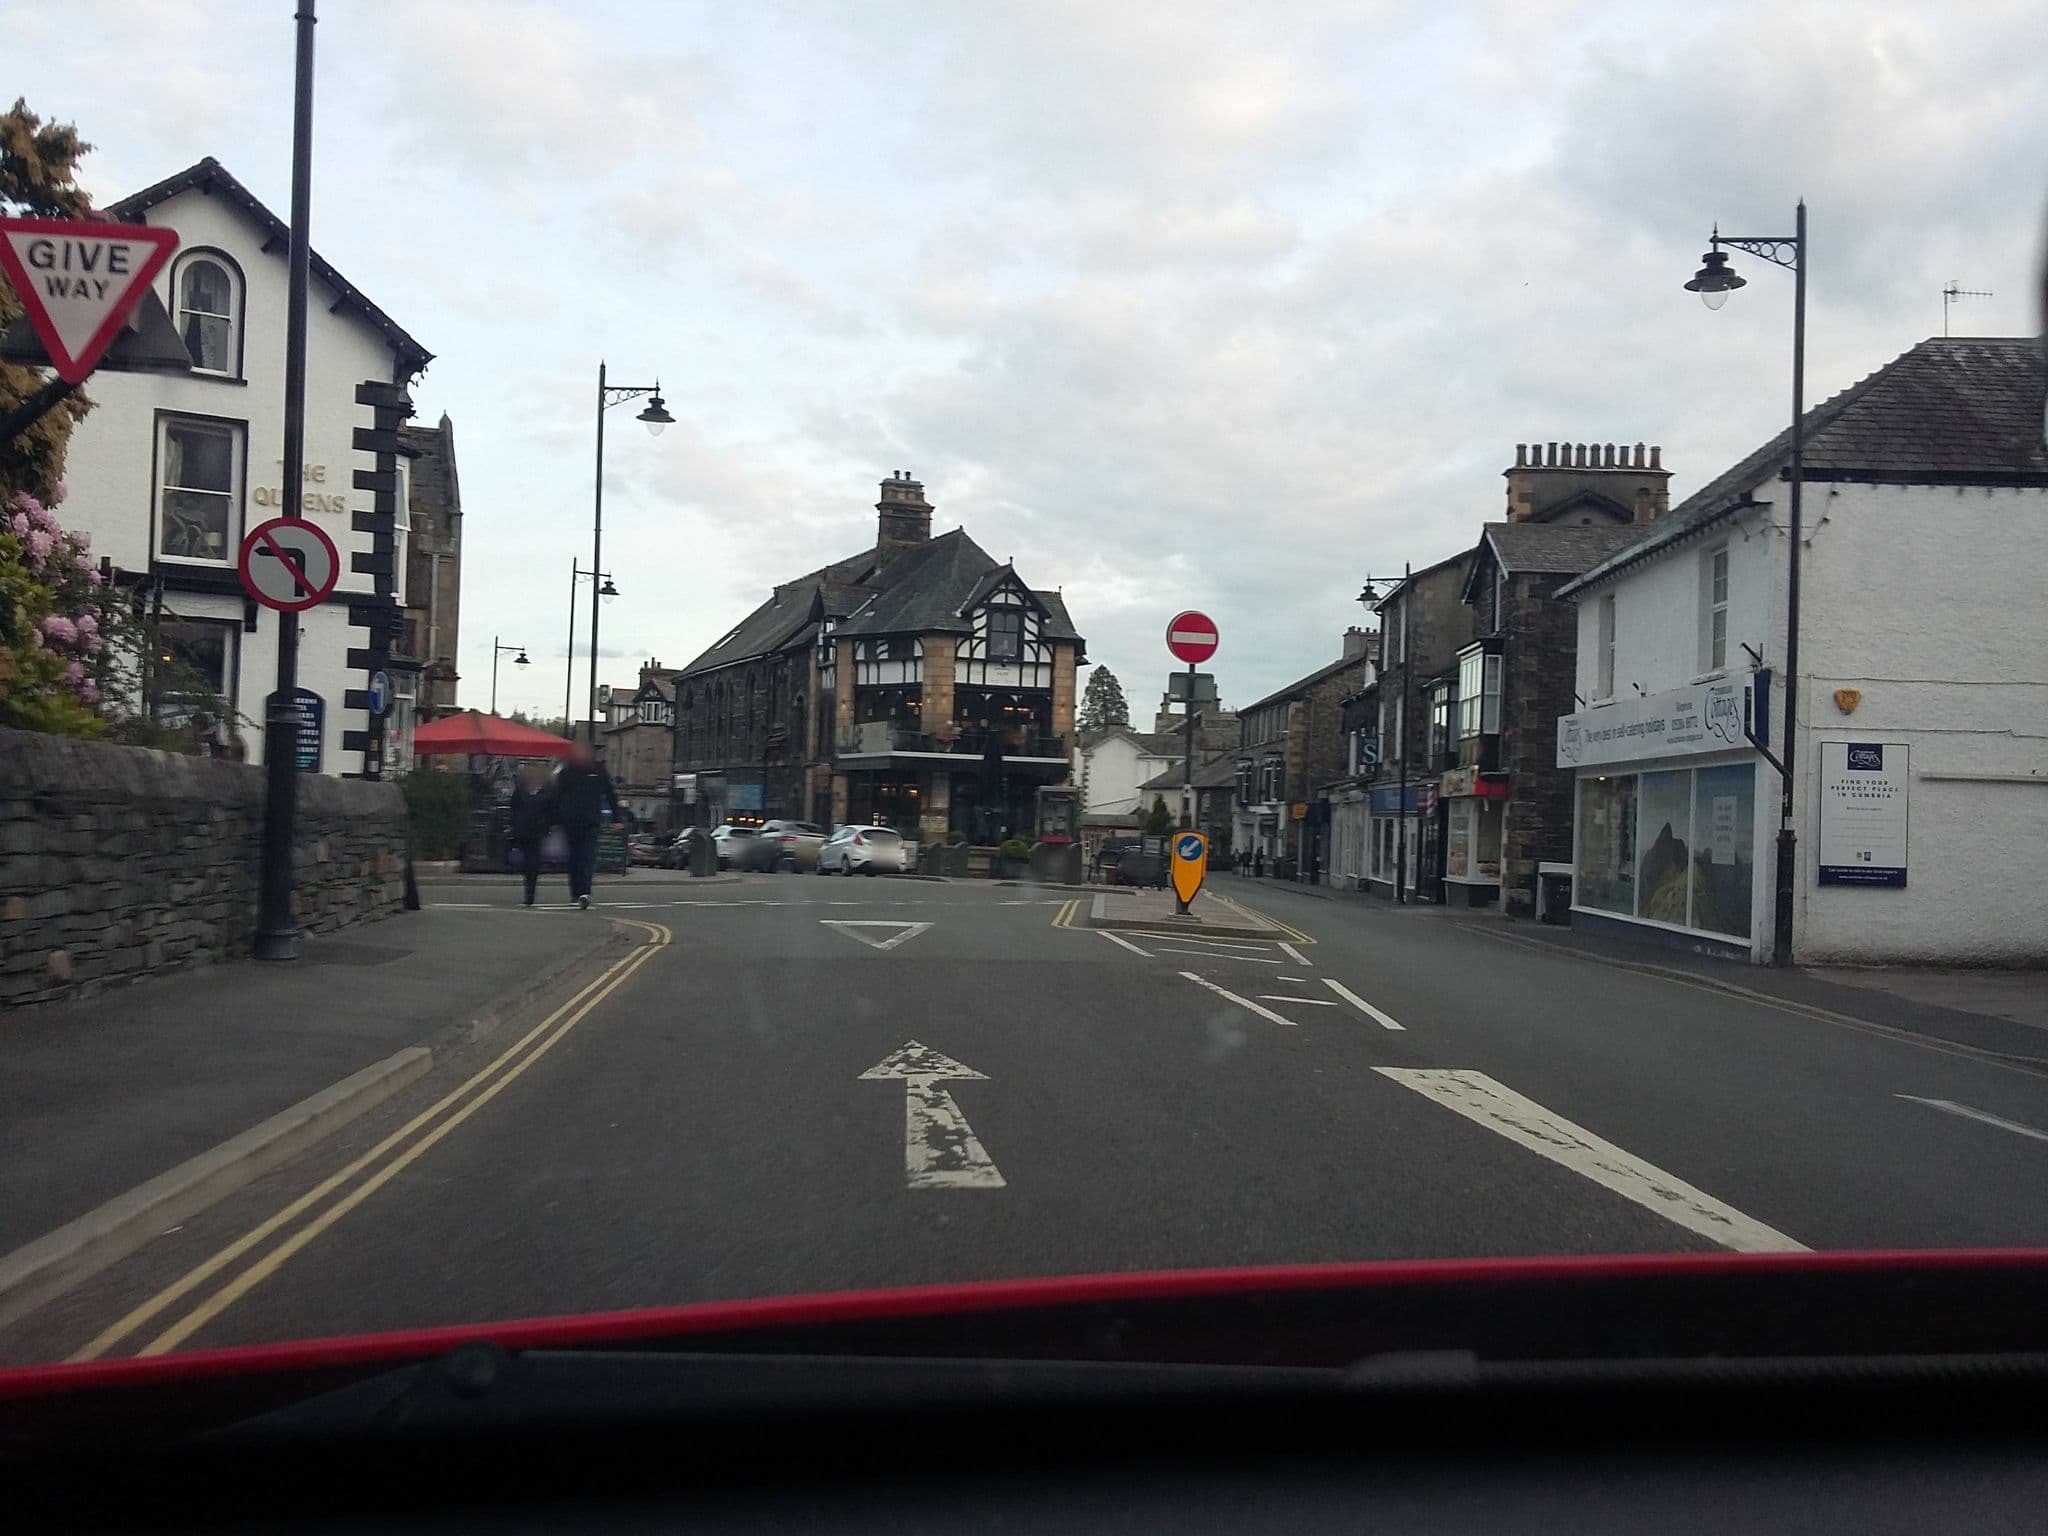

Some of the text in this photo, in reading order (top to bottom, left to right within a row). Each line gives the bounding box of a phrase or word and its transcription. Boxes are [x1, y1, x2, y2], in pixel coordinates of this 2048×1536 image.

[28, 239, 130, 275] GIVE
[45, 276, 109, 301] WAY
[255, 486, 346, 513] QUENS
